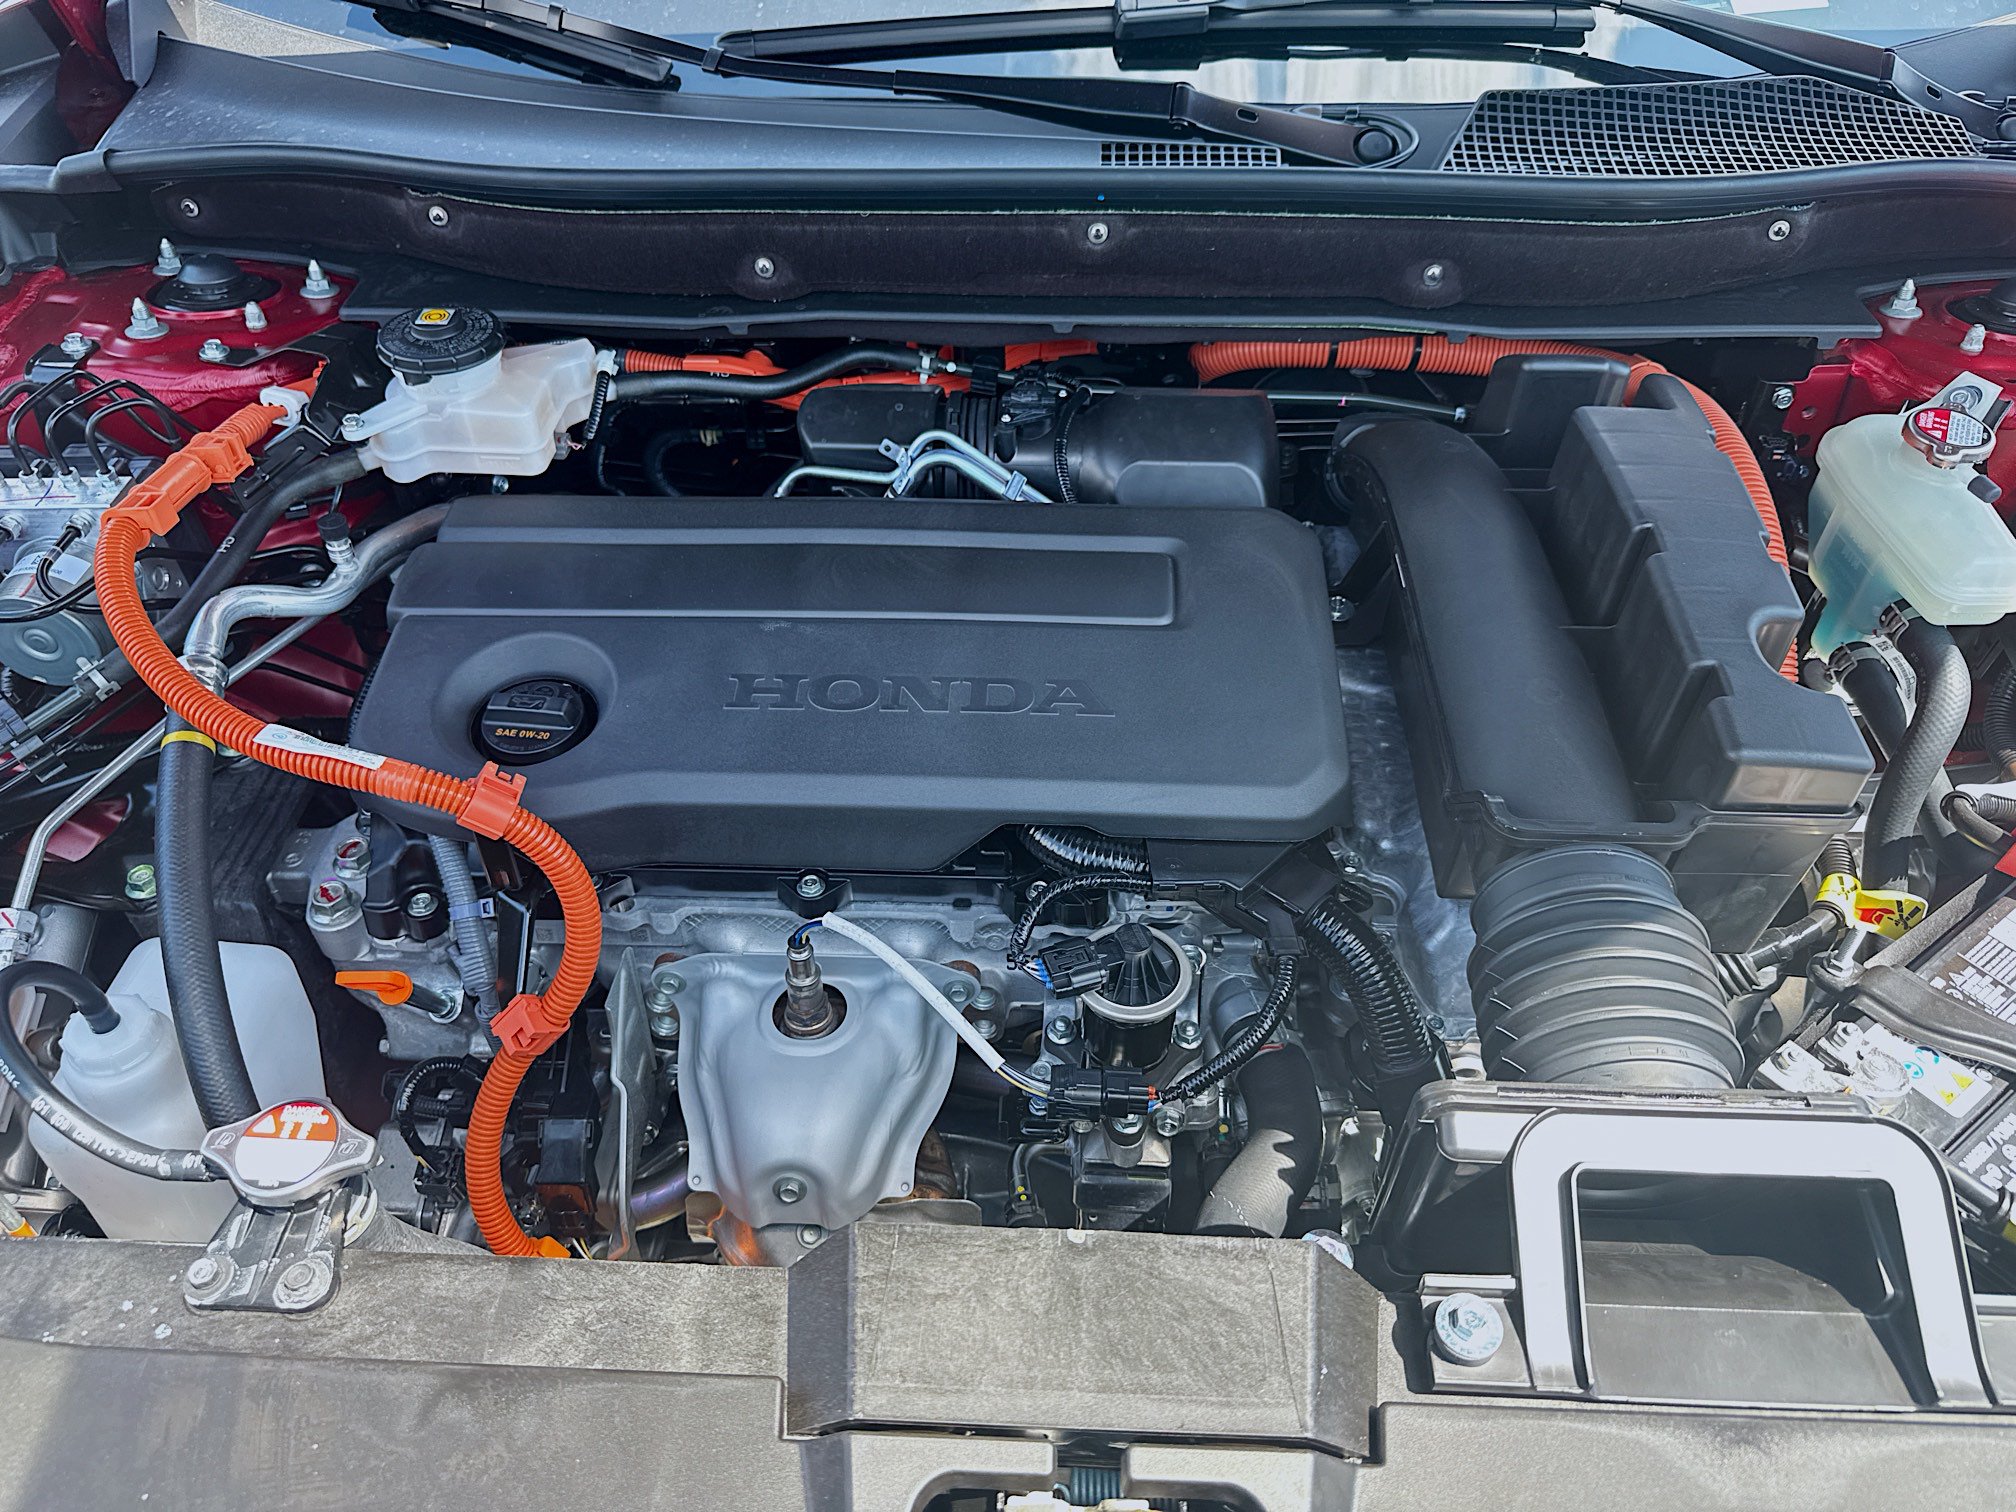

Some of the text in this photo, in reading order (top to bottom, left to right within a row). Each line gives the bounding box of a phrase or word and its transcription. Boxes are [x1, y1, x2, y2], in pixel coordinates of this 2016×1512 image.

[722, 672, 1116, 717] HONDA
[495, 728, 550, 740] SAE 0W-20
